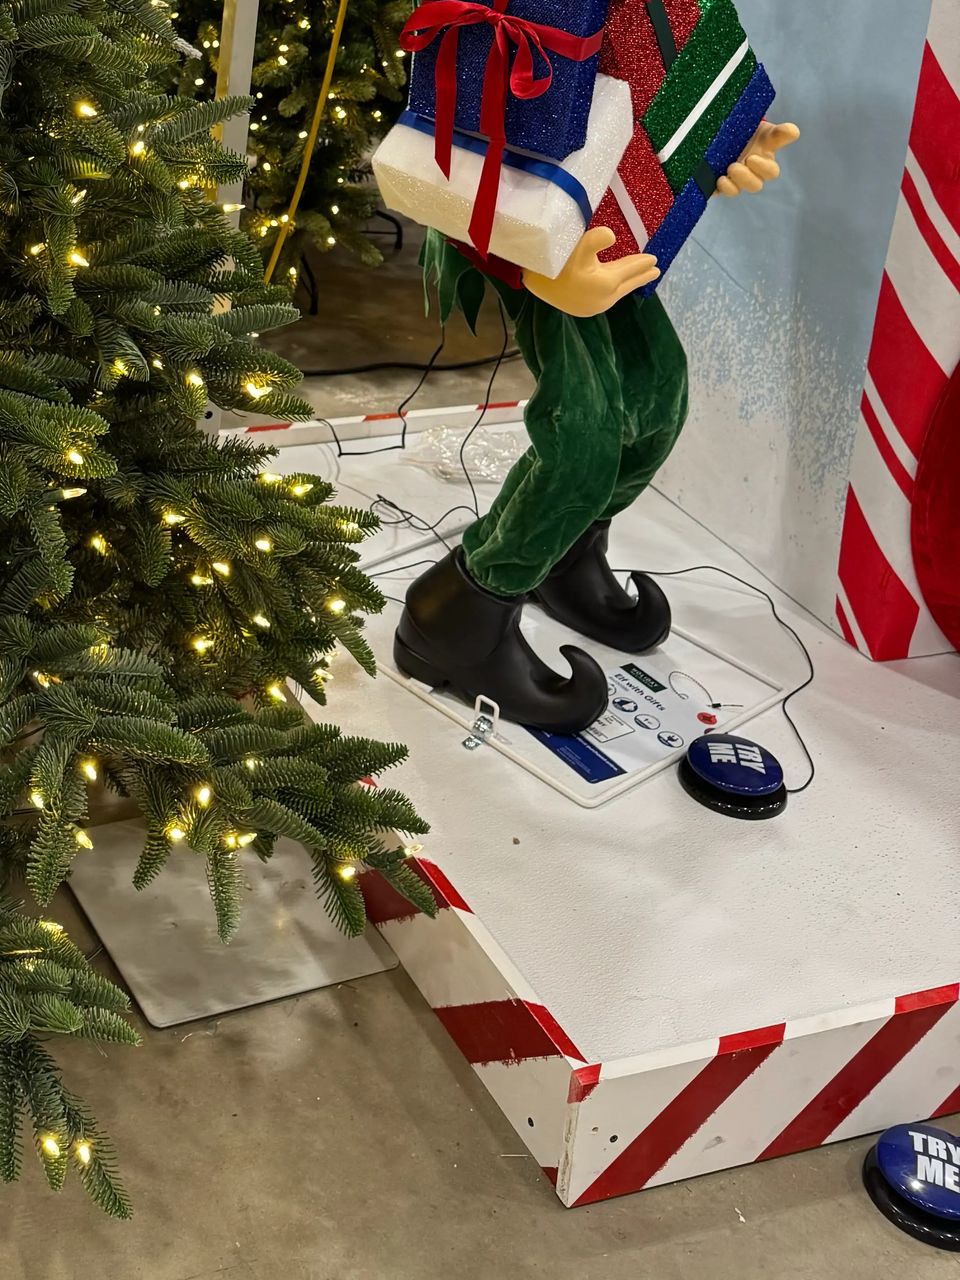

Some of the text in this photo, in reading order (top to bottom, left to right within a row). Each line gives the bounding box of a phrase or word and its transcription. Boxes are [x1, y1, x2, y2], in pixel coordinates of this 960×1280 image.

[614, 673, 666, 712] Elf with Gifts
[707, 742, 738, 764] ME
[735, 743, 767, 775] TRY
[908, 1131, 960, 1166] TRY
[917, 1154, 960, 1194] ME
